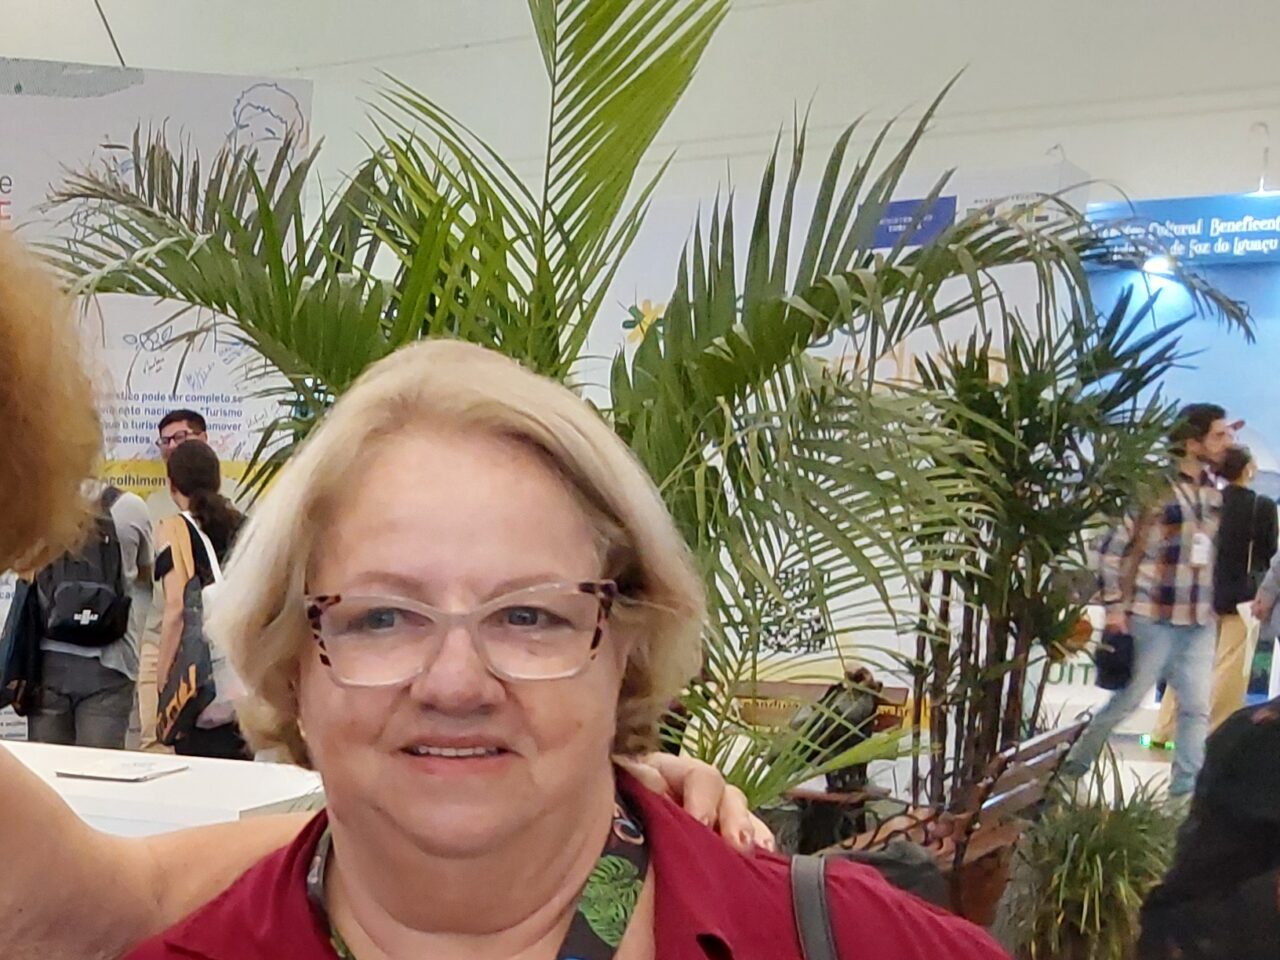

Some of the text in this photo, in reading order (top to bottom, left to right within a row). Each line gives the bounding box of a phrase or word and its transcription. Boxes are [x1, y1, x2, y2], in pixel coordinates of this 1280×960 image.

[1214, 236, 1230, 254] do
[141, 391, 166, 403] pode
[185, 391, 231, 404] completo
